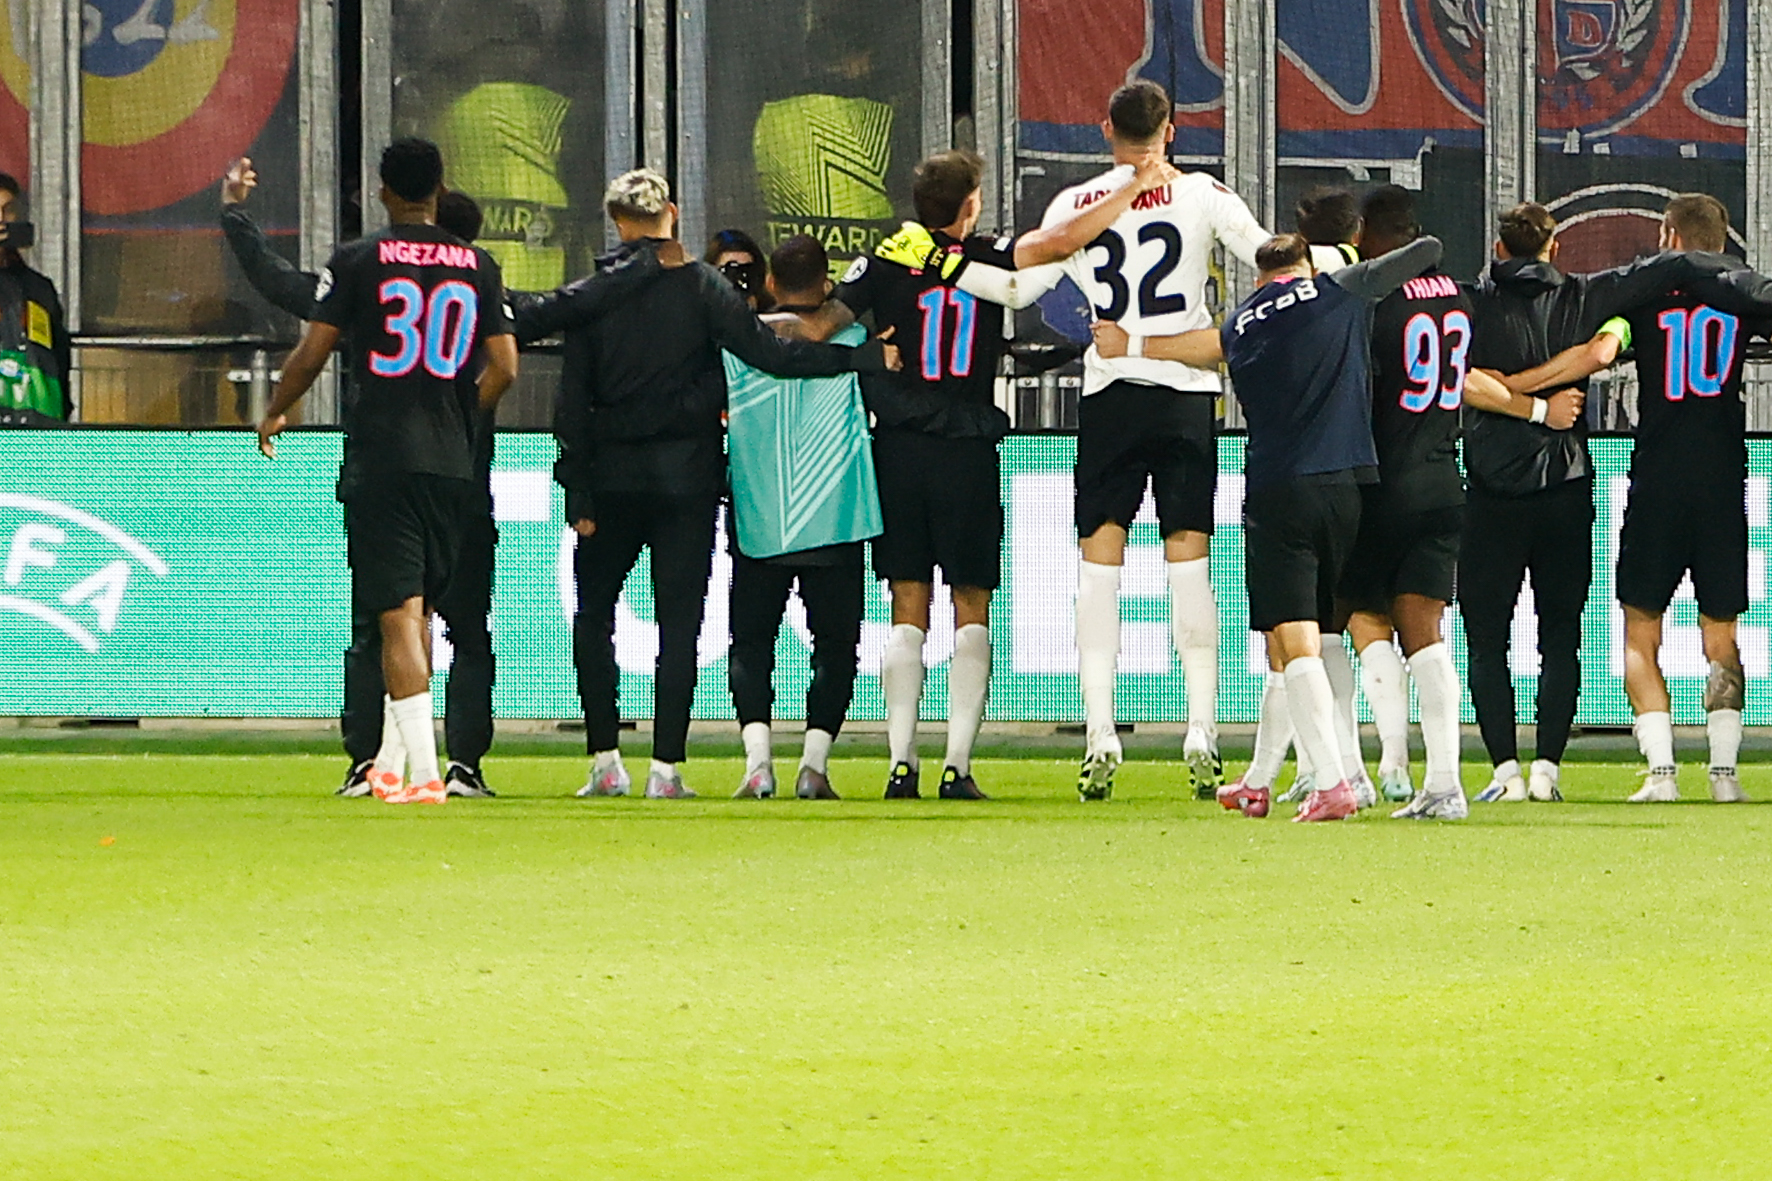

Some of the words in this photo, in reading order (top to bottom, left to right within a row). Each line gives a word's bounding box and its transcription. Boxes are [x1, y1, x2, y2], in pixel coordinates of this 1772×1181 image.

[378, 239, 478, 271] NGEZANA
[1083, 220, 1187, 320] 32
[368, 276, 478, 380] 30
[917, 284, 978, 382] 11
[1399, 309, 1473, 414] 93
[1657, 303, 1740, 403] 10
